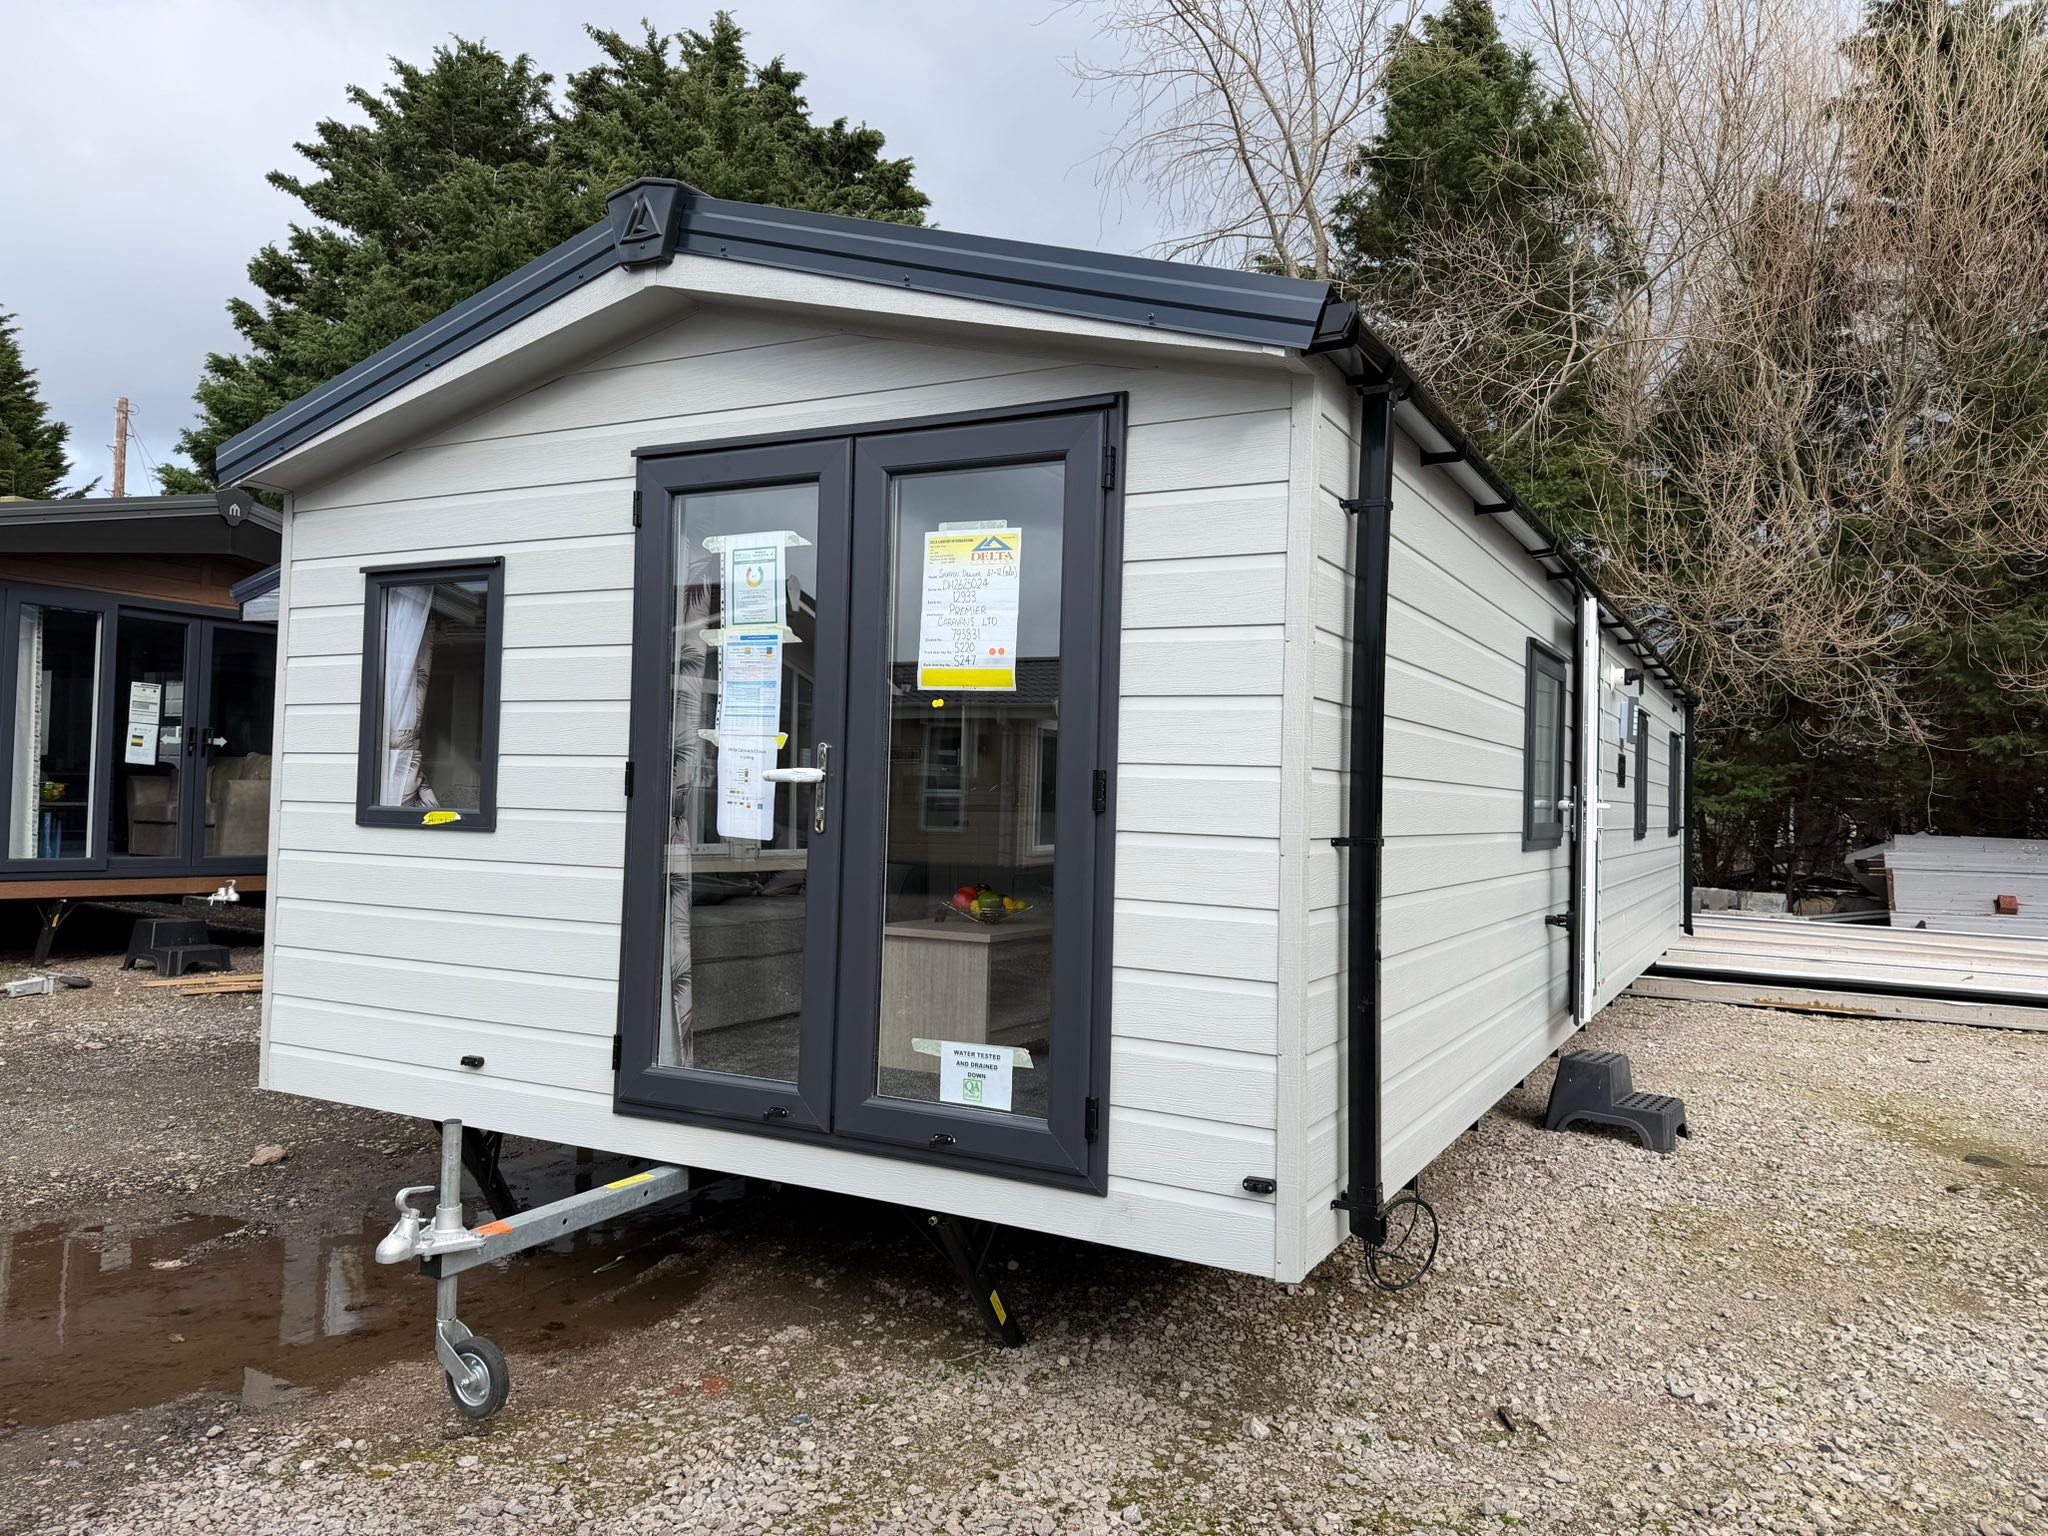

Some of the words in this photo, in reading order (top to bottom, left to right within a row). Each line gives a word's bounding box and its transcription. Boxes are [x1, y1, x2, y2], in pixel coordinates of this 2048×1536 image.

[971, 552, 1014, 561] DELTA
[953, 590, 977, 604] 12933
[949, 603, 987, 616] PREMIER
[982, 616, 998, 627] LTD
[951, 628, 981, 641] 793831
[954, 642, 975, 654] S220
[953, 655, 977, 667] S247
[953, 1050, 976, 1058] WATER
[977, 1052, 1001, 1060] TESTED
[970, 1062, 998, 1070] DRAINED
[964, 1081, 980, 1094] QA
